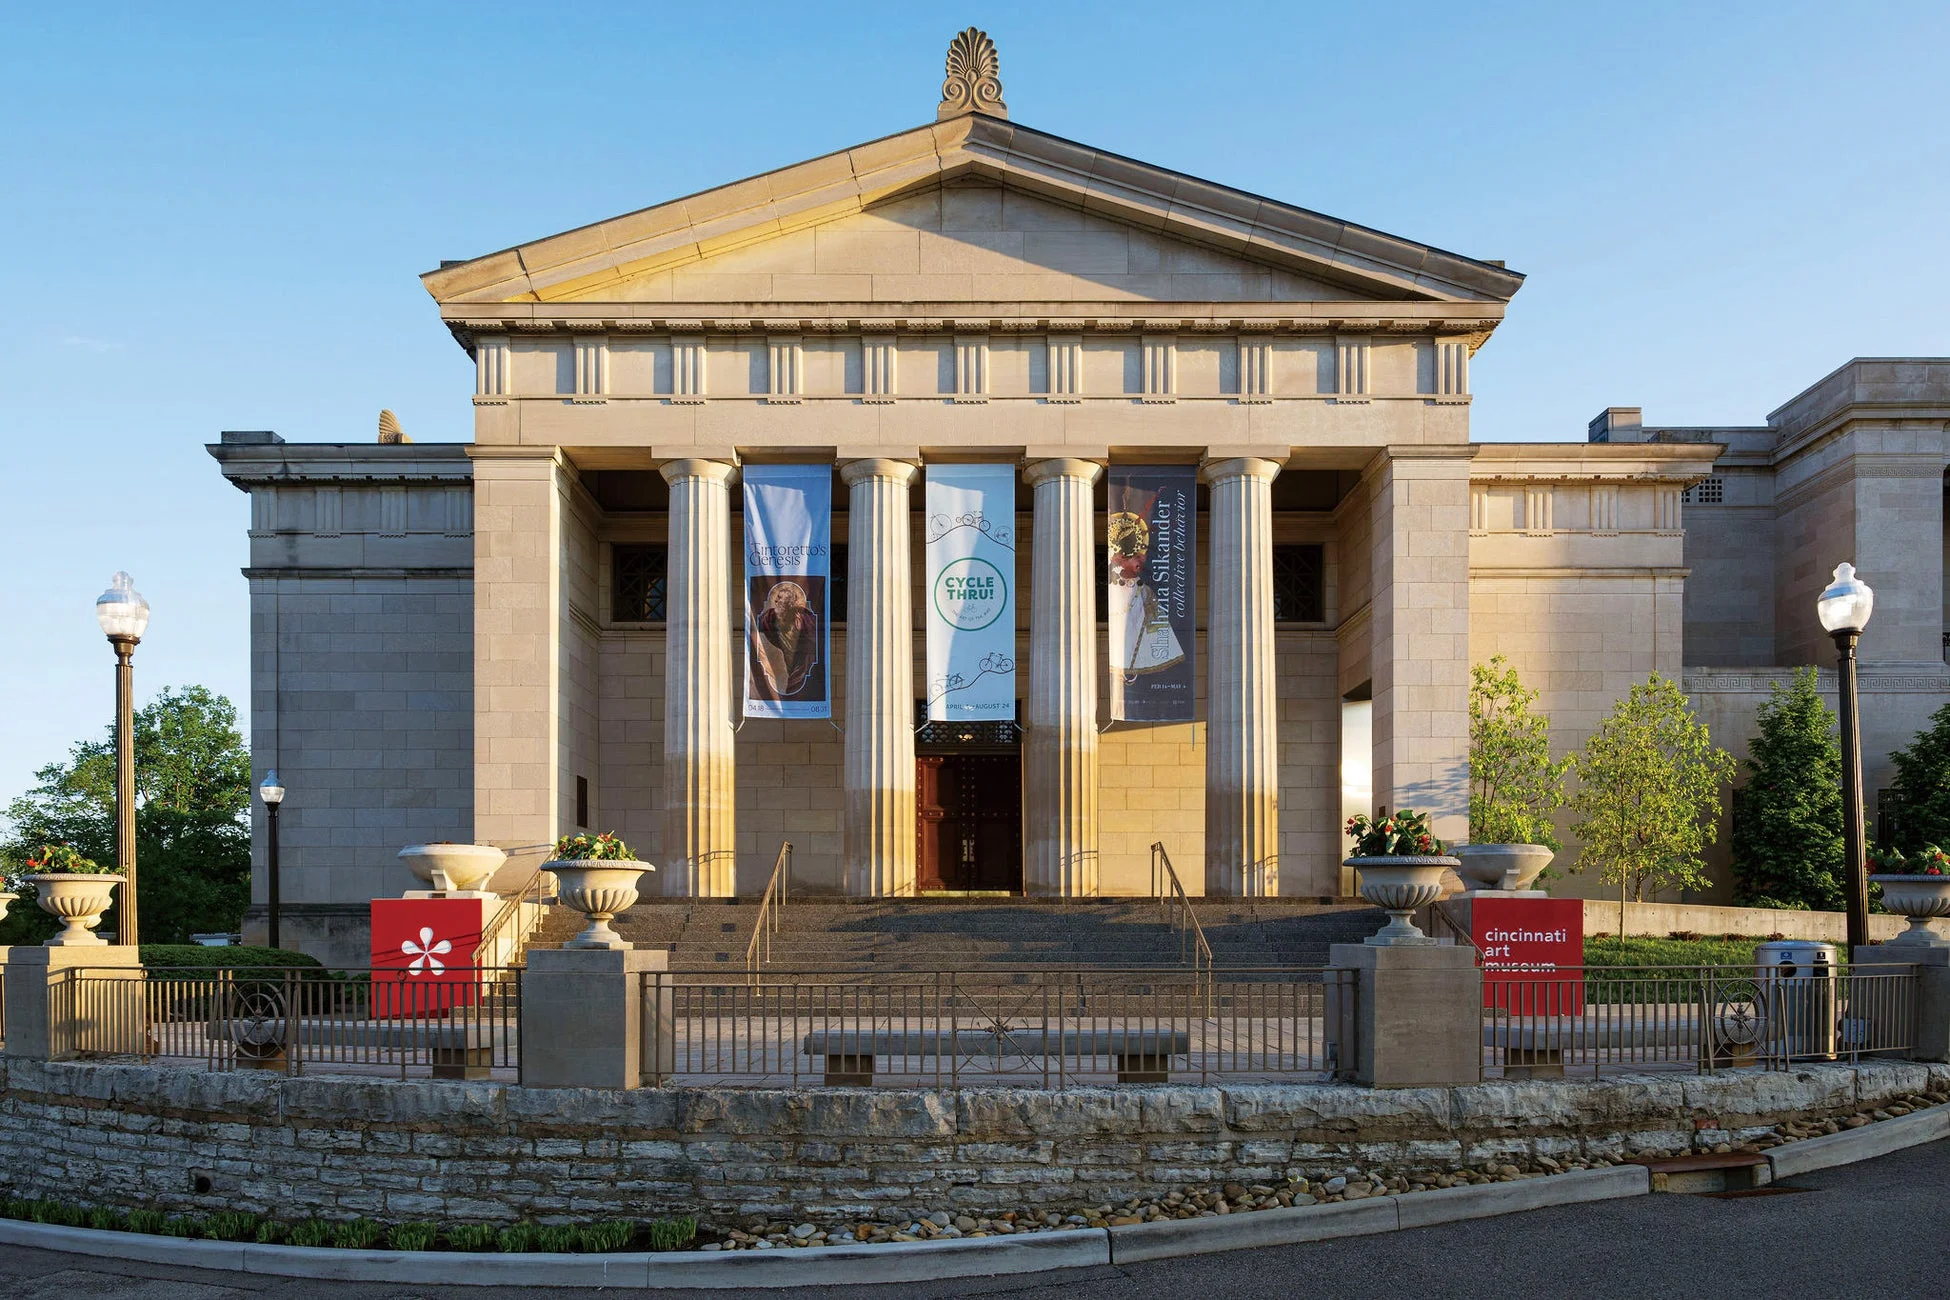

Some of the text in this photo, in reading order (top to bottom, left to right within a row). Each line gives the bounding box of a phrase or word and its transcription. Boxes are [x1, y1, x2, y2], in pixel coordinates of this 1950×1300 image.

[750, 542, 827, 557] Tintoretto's
[1173, 489, 1186, 618] collective behavior
[750, 550, 801, 569] Genesis
[945, 576, 994, 588] CYCLE
[1151, 500, 1171, 660] Shahzia Sikander
[947, 589, 994, 600] THRU!
[1485, 928, 1567, 942] cincinnati
[1485, 944, 1510, 957] art
[1485, 961, 1556, 973] museum
